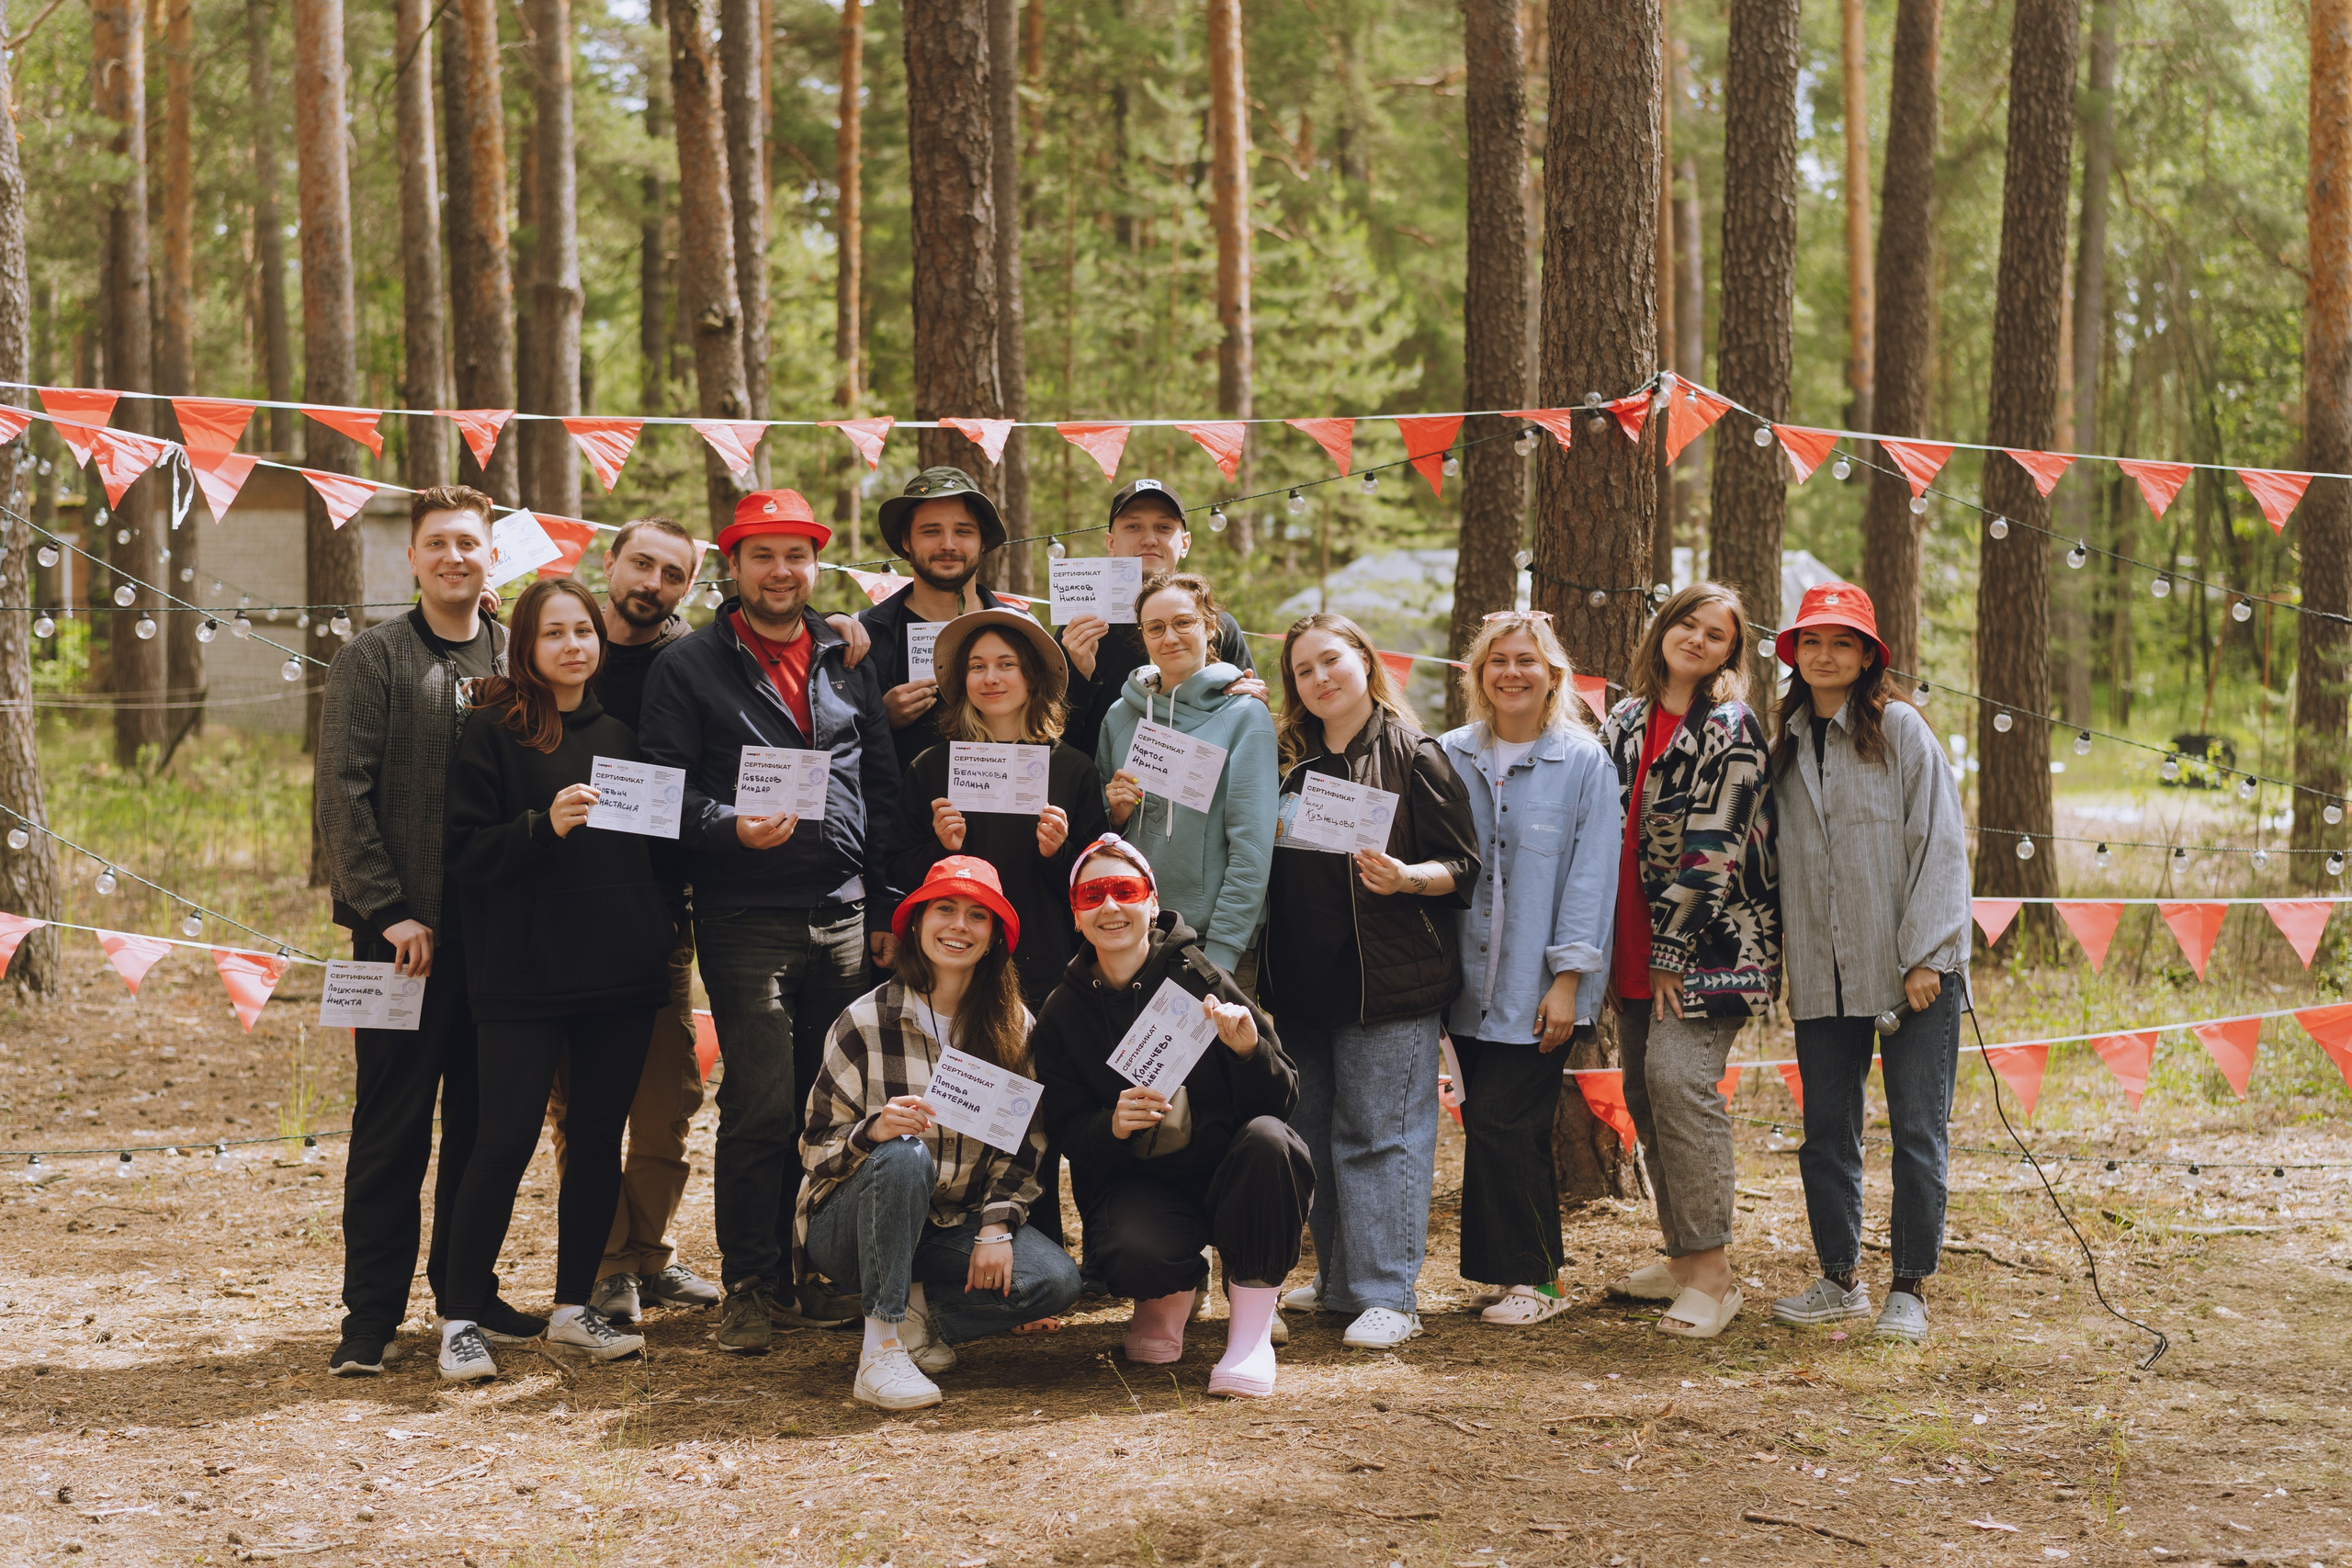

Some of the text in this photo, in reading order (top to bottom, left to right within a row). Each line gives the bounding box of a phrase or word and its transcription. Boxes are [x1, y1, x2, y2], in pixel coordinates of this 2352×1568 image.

[1138, 734, 1185, 755] СЕРТИФИКАТ
[596, 773, 644, 784] СЕРТИФИКАТ
[1307, 785, 1355, 802] СЕРТИФИКАТ
[1123, 1024, 1157, 1071] СЕРТИФИКАТ
[942, 1064, 995, 1089] СЕРТИФИКАТ
